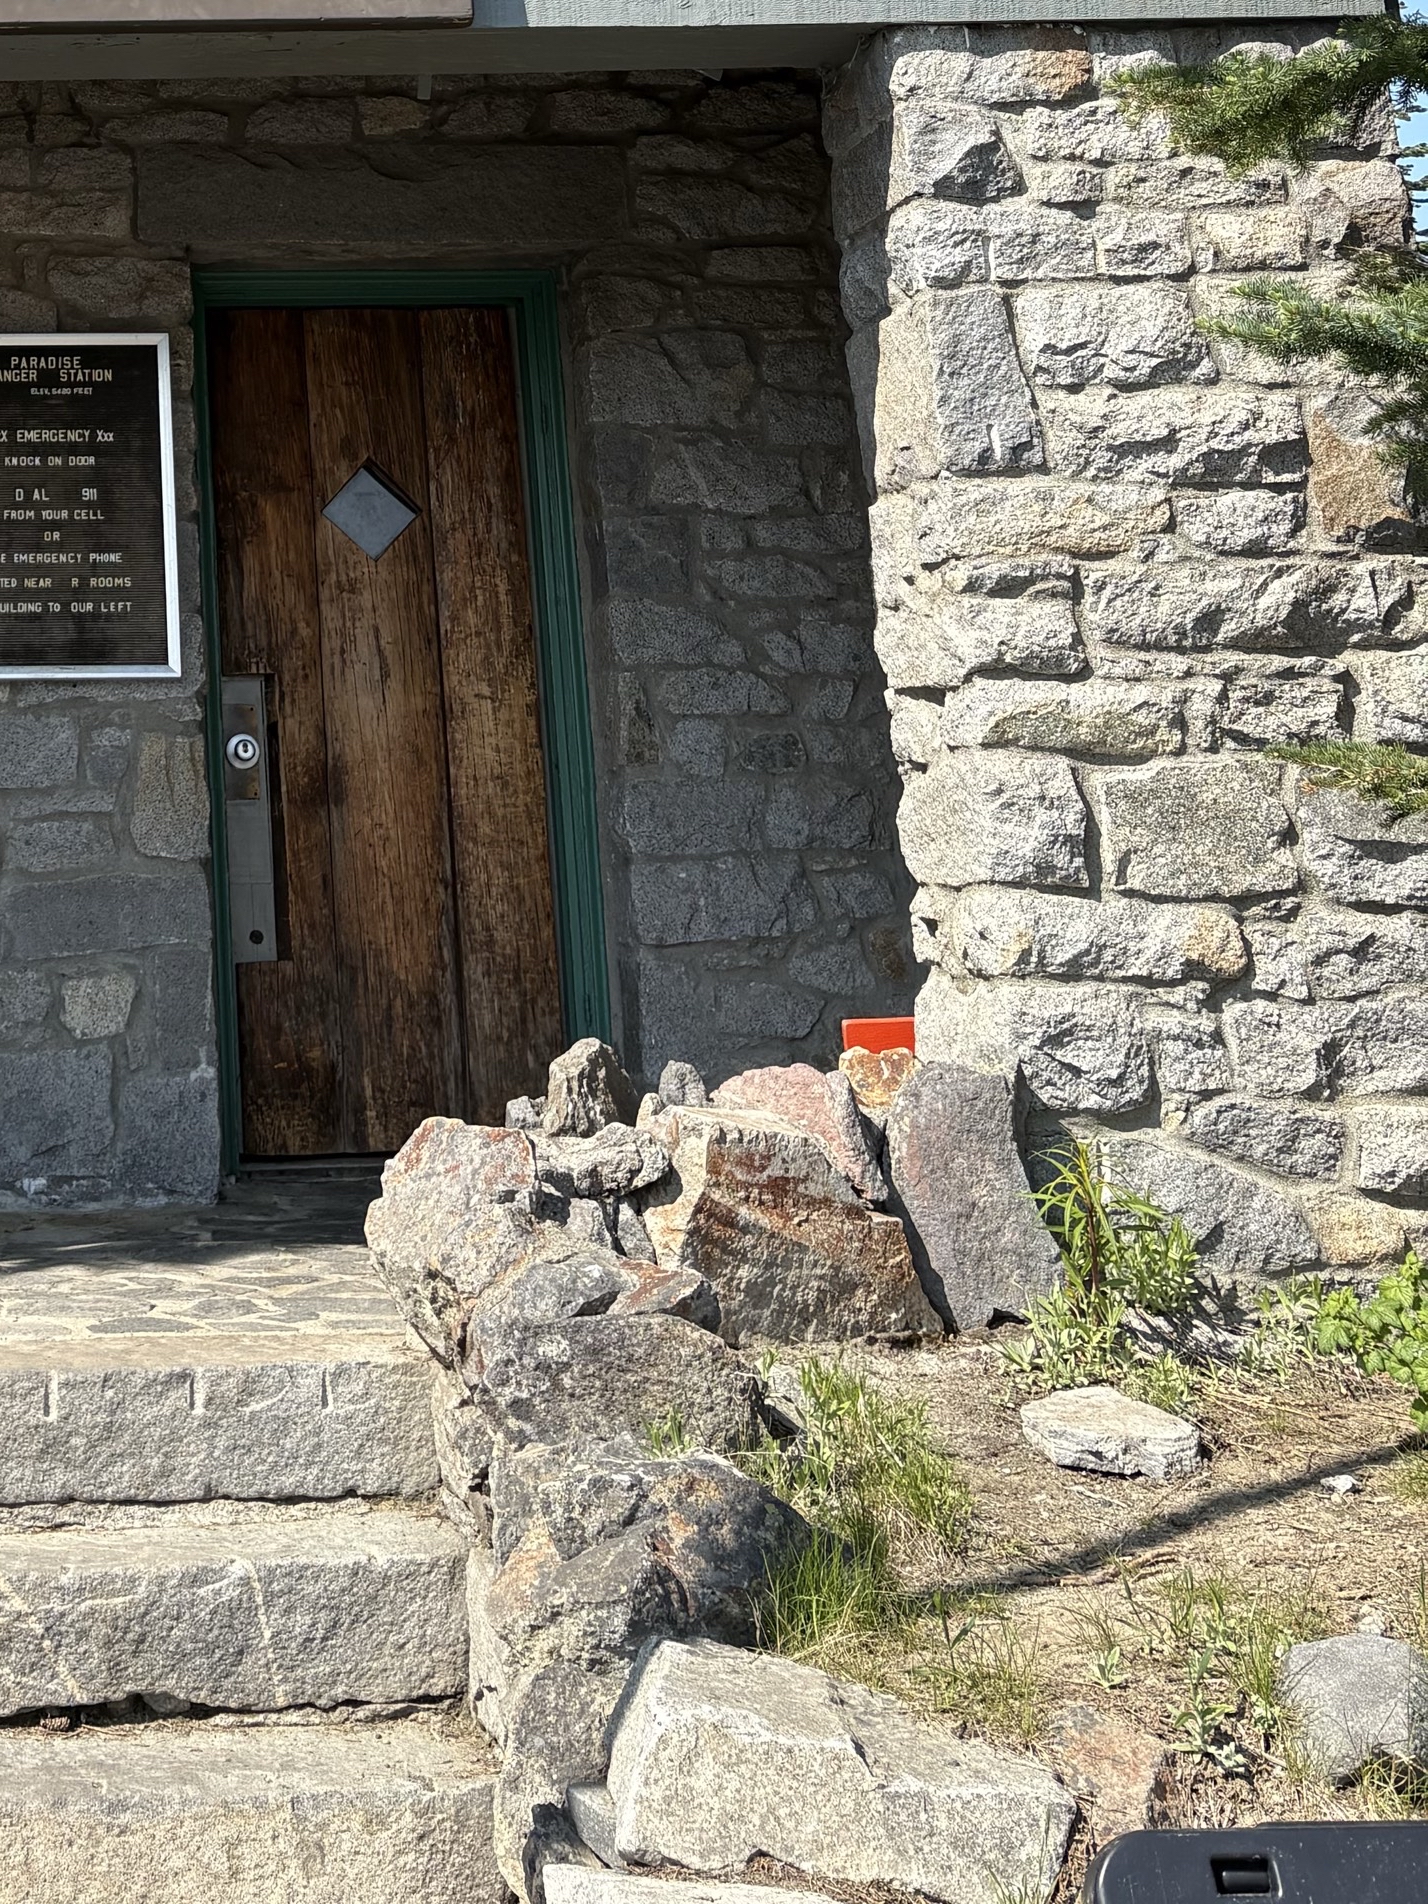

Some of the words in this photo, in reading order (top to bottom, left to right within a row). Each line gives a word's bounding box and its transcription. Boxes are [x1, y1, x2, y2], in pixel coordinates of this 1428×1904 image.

[10, 356, 82, 369] PARADISE
[59, 368, 113, 382] STATION
[16, 429, 91, 442] EMERGENCY
[4, 456, 41, 466] KNOCK
[47, 456, 62, 466] ON
[68, 456, 96, 466] DOOR
[81, 488, 97, 501] 911
[3, 510, 35, 520] FROM
[41, 510, 69, 520] YOUR
[74, 510, 105, 520] CELL
[43, 531, 61, 542] OR
[13, 553, 82, 563] EMERGENCY
[89, 552, 123, 563] PHONE
[24, 578, 52, 588] NEAR
[90, 577, 132, 587] ROOMS
[47, 602, 61, 612] TO
[70, 602, 94, 612] OUR
[100, 602, 133, 612] LEFT
